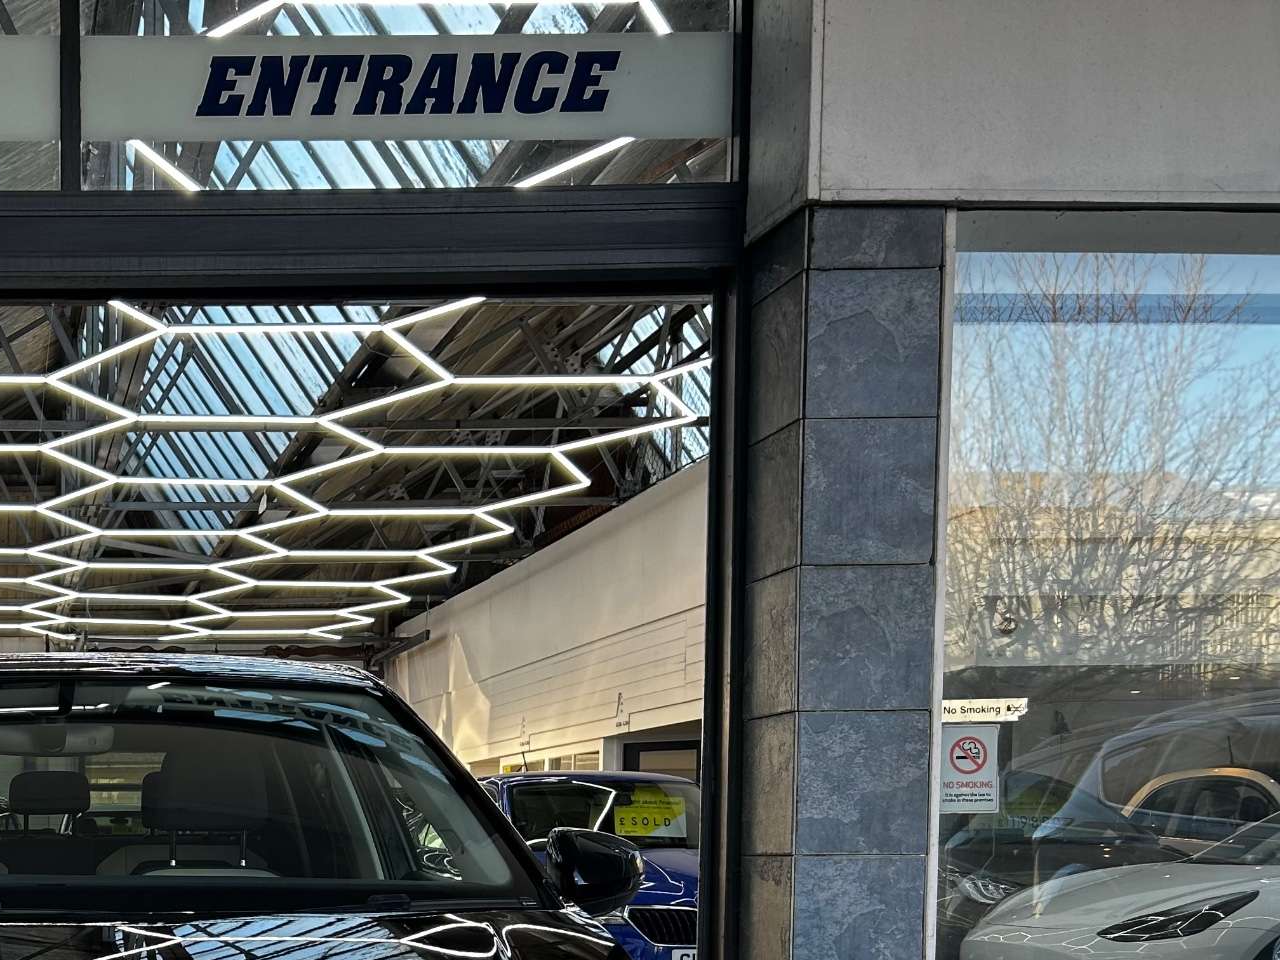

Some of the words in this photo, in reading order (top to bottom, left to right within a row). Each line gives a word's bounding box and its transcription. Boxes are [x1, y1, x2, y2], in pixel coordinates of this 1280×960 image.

[195, 50, 622, 117] ENTRANCE
[943, 706, 957, 715] No
[960, 705, 1001, 717] Smoking
[943, 781, 955, 789] NO
[955, 781, 993, 789] SMOKING
